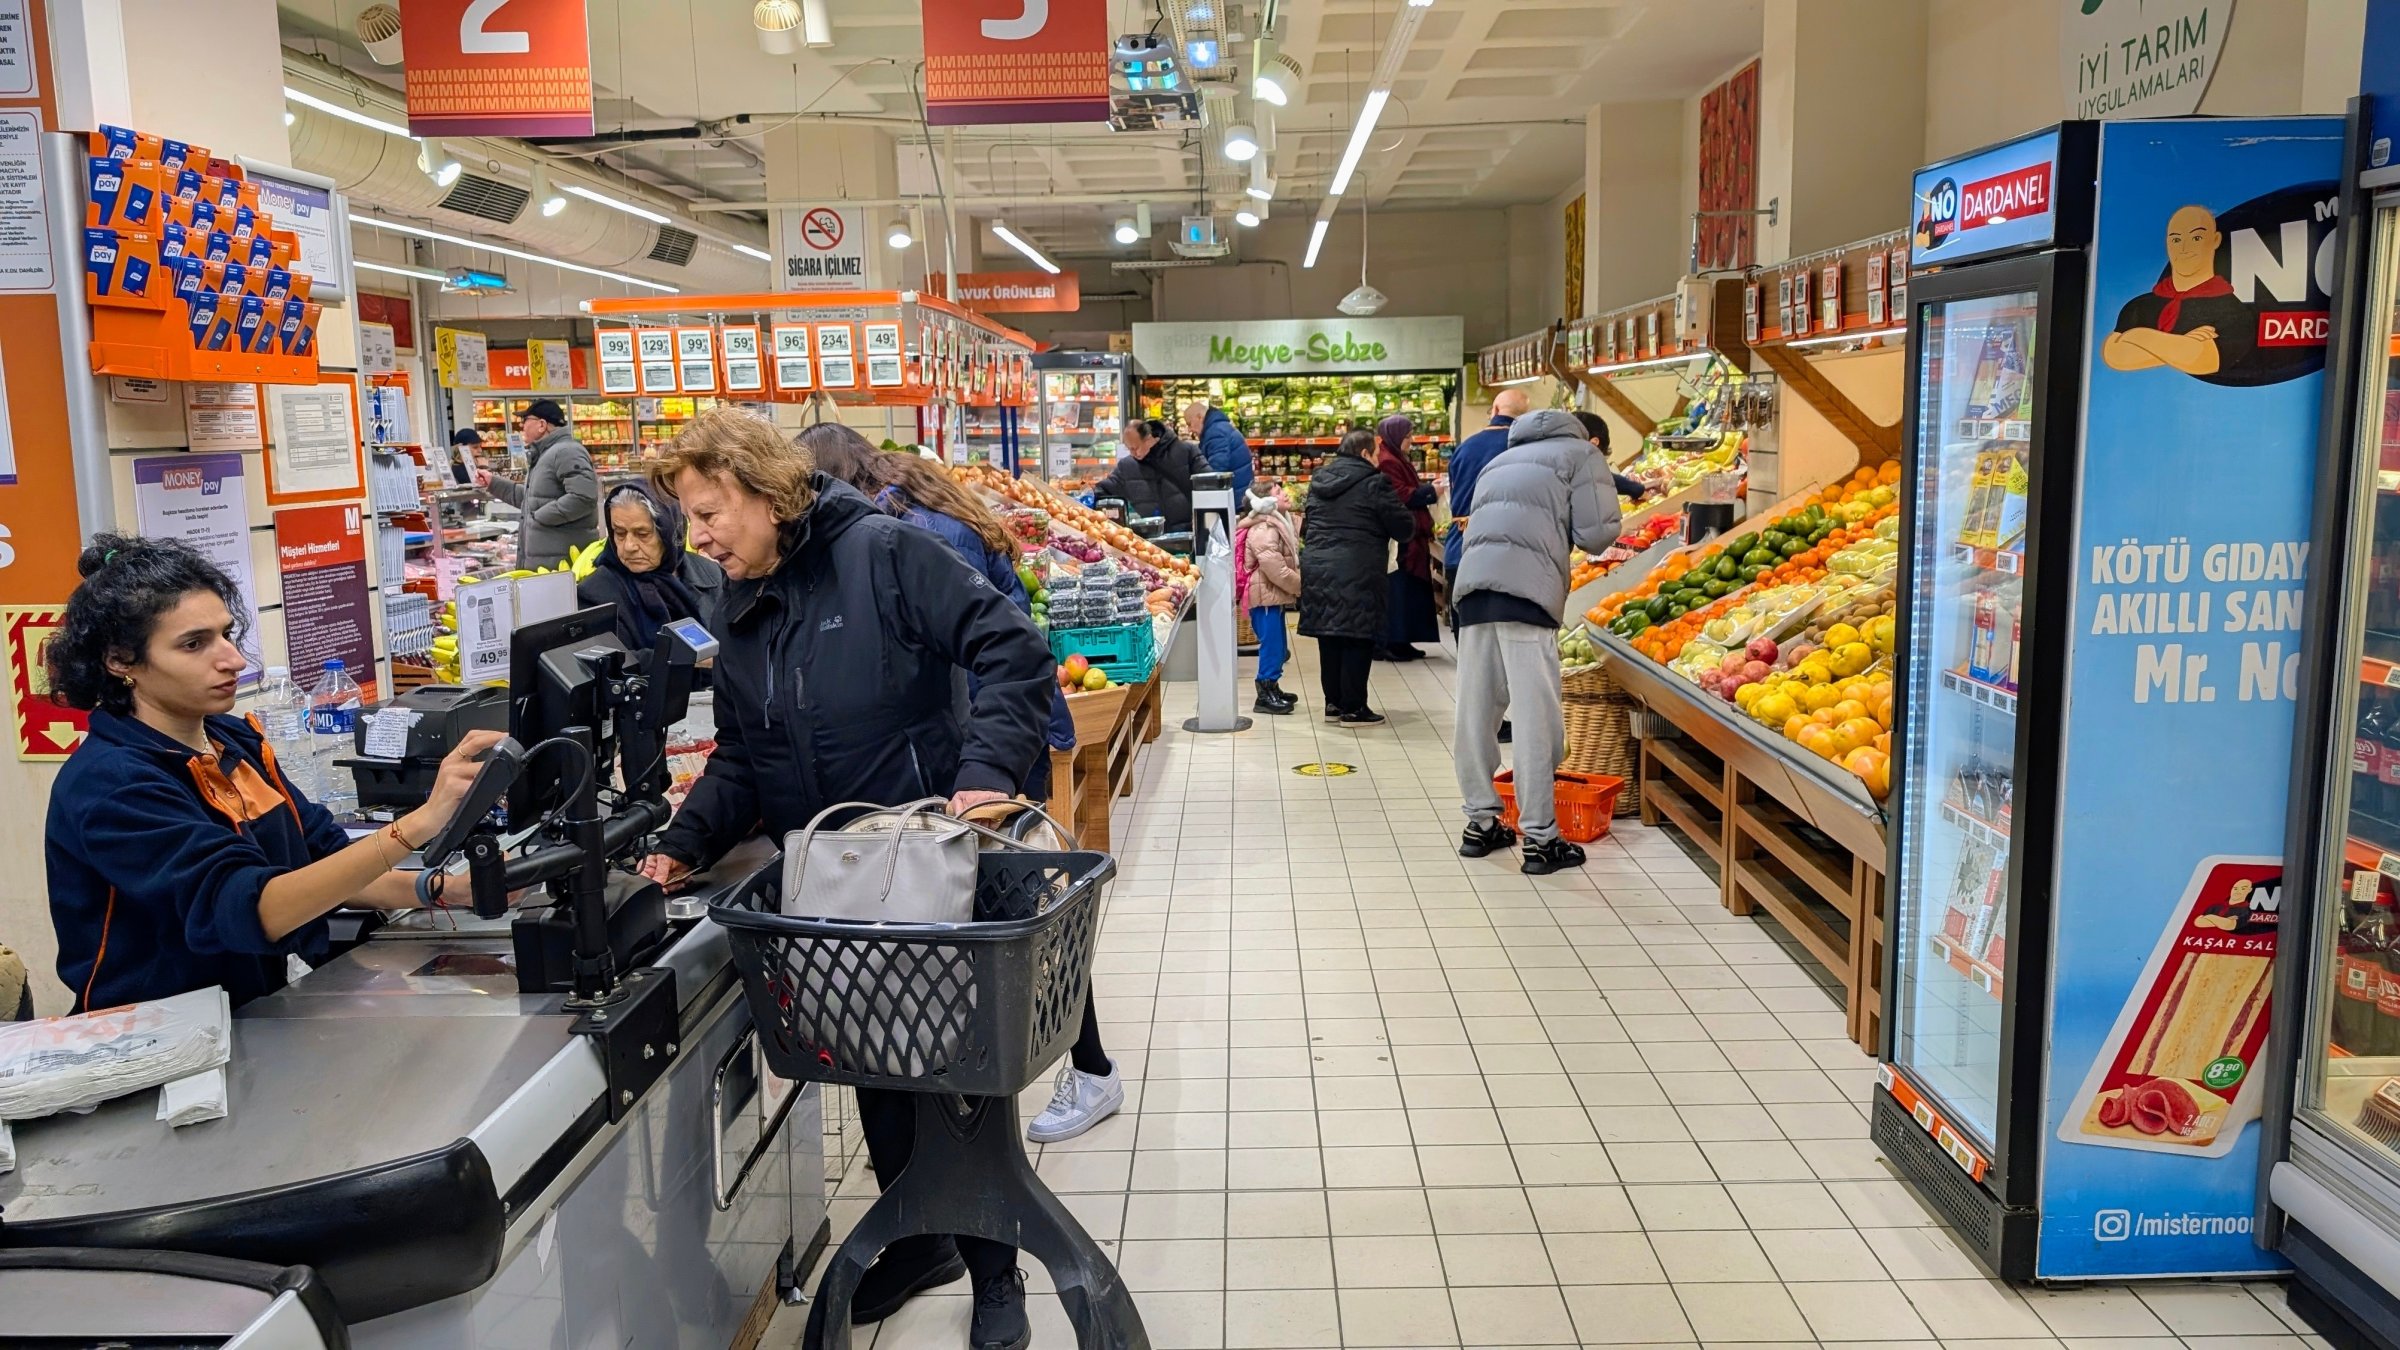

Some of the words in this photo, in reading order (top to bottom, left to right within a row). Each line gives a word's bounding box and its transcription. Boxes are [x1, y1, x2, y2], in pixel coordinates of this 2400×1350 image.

[2078, 42, 2109, 94] İYİ
[2121, 7, 2207, 75] TARIM
[2077, 55, 2204, 120] UYGULAMALARI
[99, 179, 116, 190] pay
[261, 188, 295, 213] Money
[296, 204, 310, 217] pay
[1931, 190, 1955, 222] NO
[1963, 174, 2045, 221] DARDANEL
[2313, 197, 2339, 222] M
[94, 250, 112, 261] pay
[788, 253, 822, 277] SİGARA
[825, 253, 862, 279] İÇİLMEZ
[956, 288, 991, 300] AVUK
[993, 283, 1056, 299] ÜRÜNLERİ
[196, 312, 210, 323] pay
[245, 317, 258, 327] pay
[2264, 318, 2330, 341] DARD
[609, 340, 624, 352] 99
[642, 340, 664, 350] 129
[688, 338, 703, 350] 99
[734, 337, 748, 348] 59
[784, 336, 799, 347] 96
[822, 334, 843, 346] 234
[875, 333, 890, 344] 49
[1209, 331, 1387, 371] Meyve-Sebze
[164, 471, 202, 488] MONEY
[203, 480, 220, 493] pay
[344, 507, 360, 530] M
[281, 544, 307, 559] Müşteri
[307, 540, 340, 554] Hizmetleri
[2091, 536, 2191, 584] KÖTÜ
[2202, 542, 2311, 582] GIDAY
[2091, 591, 2211, 635] AKILLI
[2223, 589, 2304, 633] SAN
[498, 650, 508, 658] 95
[2133, 643, 2216, 704] Mr.
[2249, 913, 2279, 922] DARD
[2182, 934, 2236, 954] KAŞAR
[2243, 940, 2274, 951] SAL
[2184, 1114, 2193, 1126] 2
[2192, 1115, 2217, 1128] ADET
[2134, 1213, 2255, 1237] /misternoo
